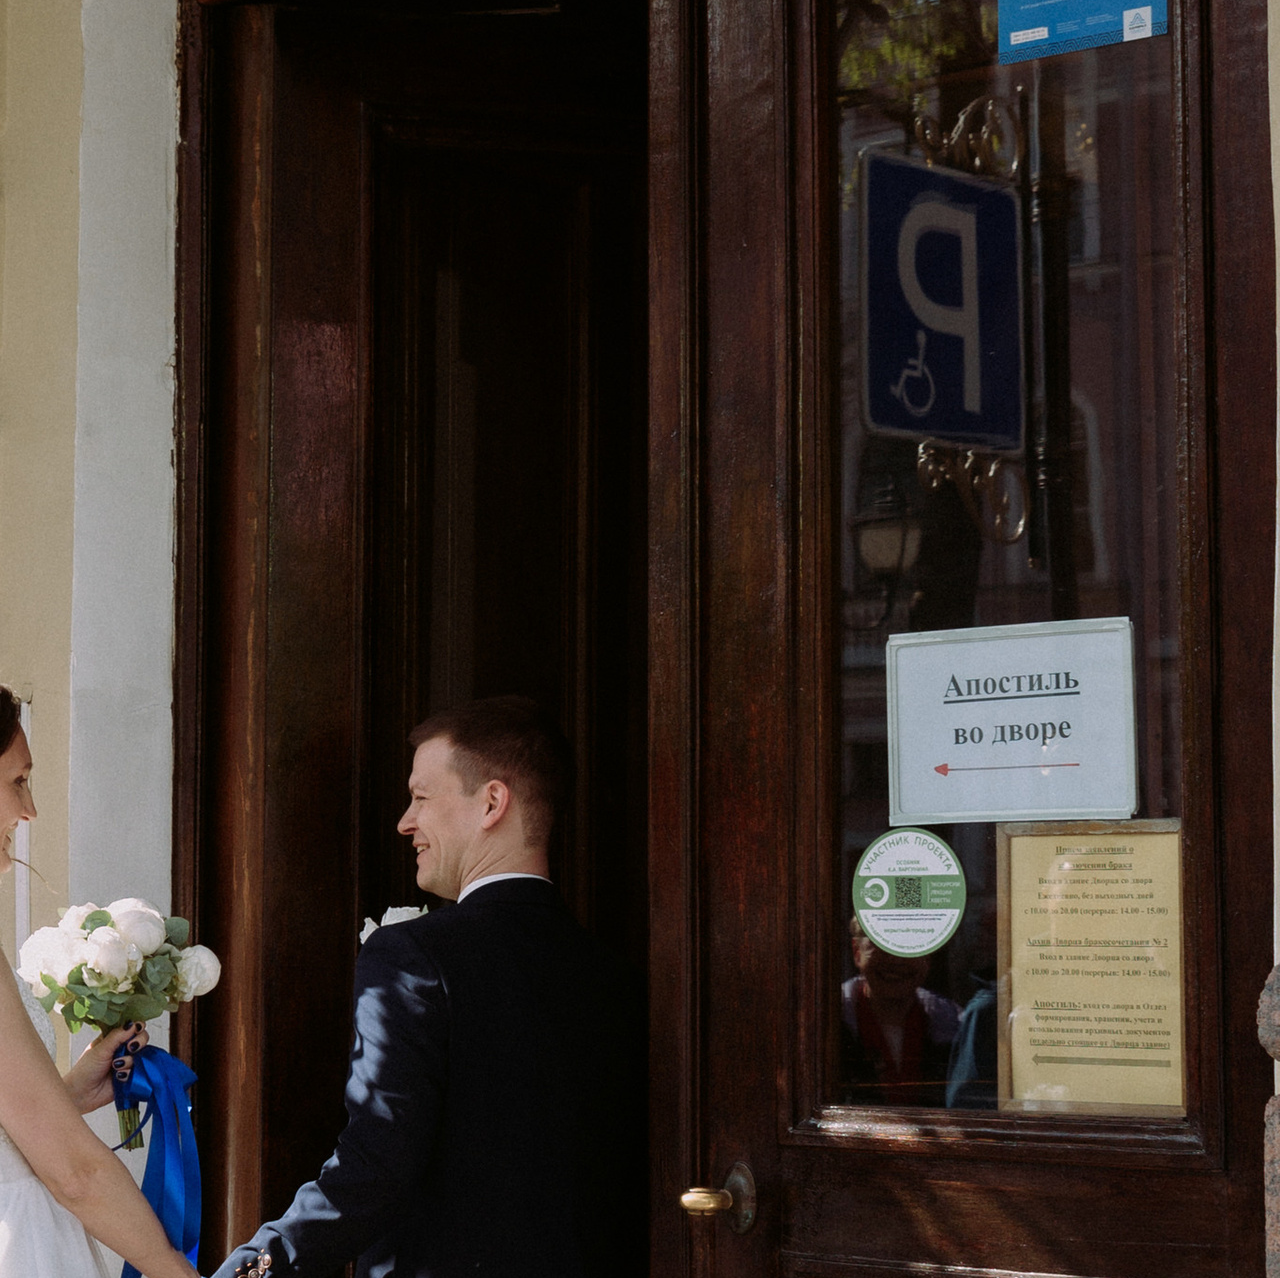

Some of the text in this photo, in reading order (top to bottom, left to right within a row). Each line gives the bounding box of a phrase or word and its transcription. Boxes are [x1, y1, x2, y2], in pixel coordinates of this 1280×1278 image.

[944, 672, 1079, 698] Апостиль
[954, 720, 1071, 746] во дворе
[864, 835, 953, 873] УЧАСТНИК ПРОЕКТА
[1108, 861, 1133, 870] брака
[1146, 907, 1169, 915] 15.00)
[1032, 1000, 1081, 1008] Апостиль:
